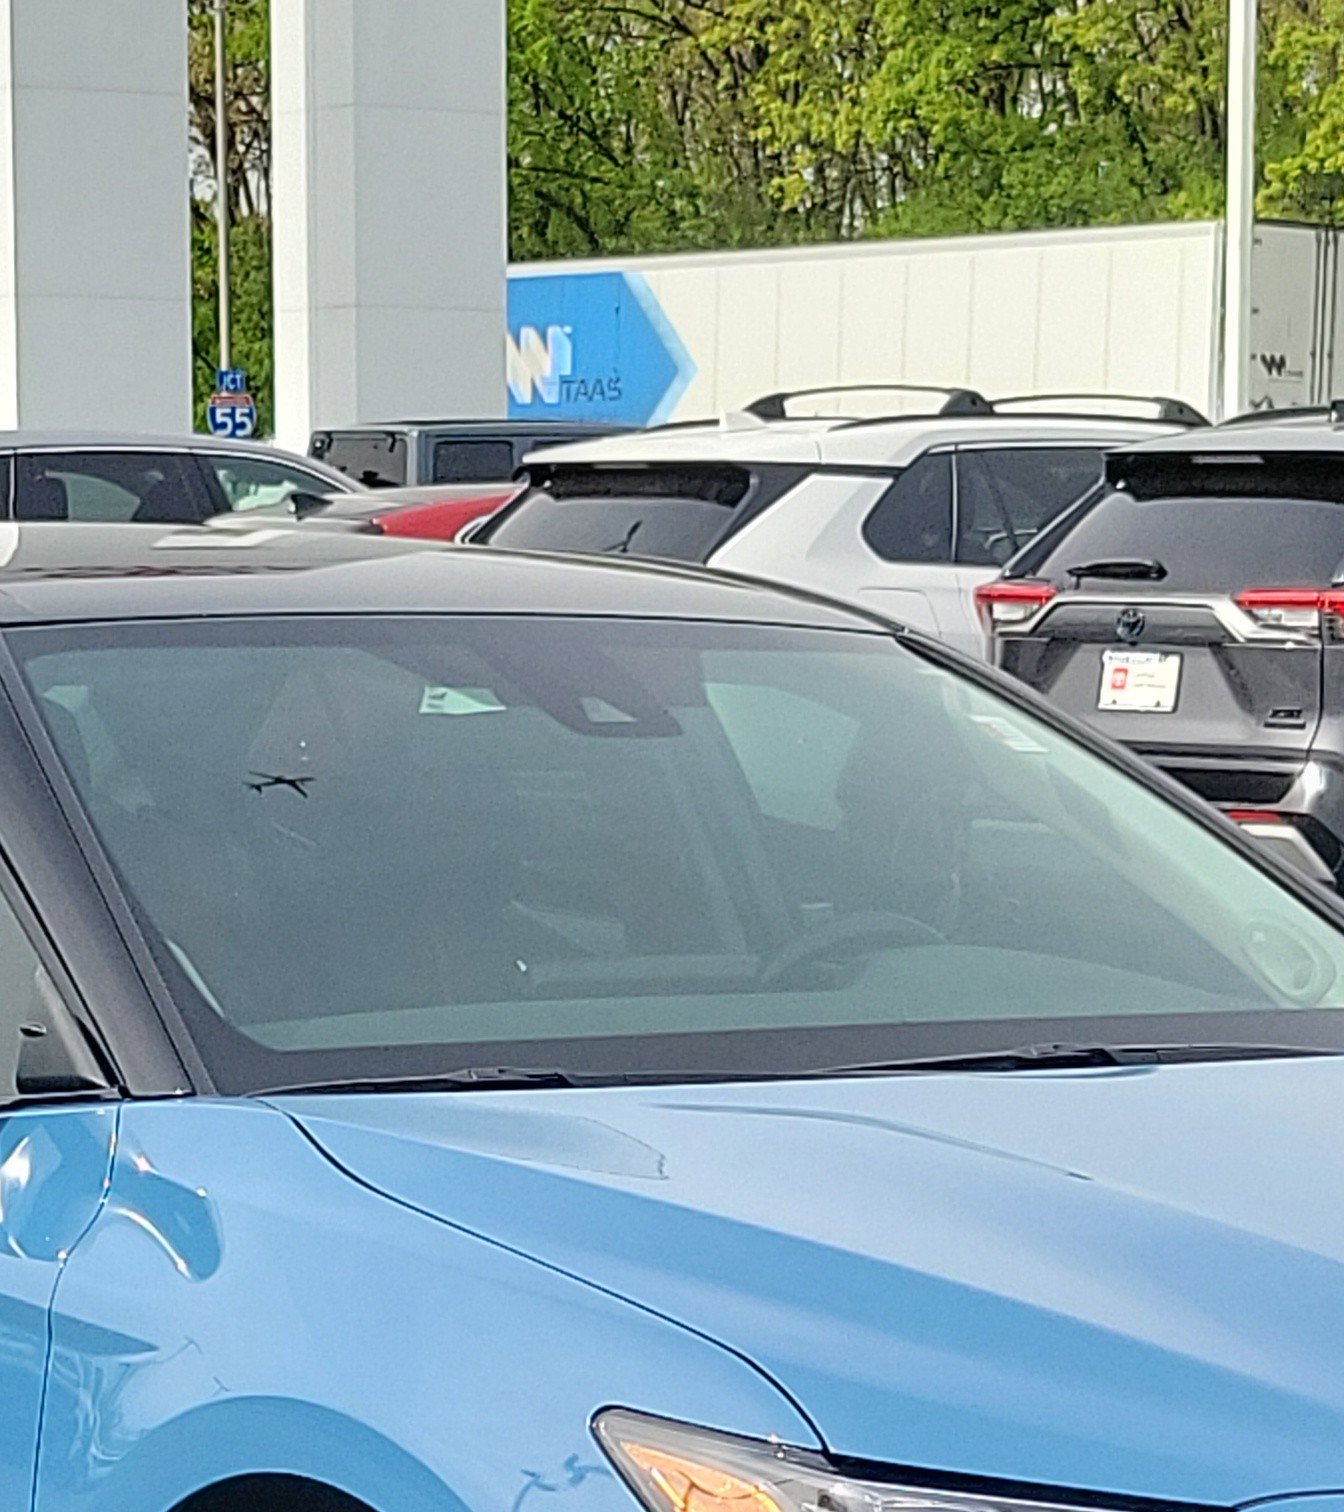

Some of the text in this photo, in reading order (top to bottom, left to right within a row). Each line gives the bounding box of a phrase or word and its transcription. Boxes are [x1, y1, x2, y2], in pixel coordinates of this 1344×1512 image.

[222, 373, 242, 392] JCT
[561, 378, 622, 402] TAAS
[214, 408, 253, 437] 55
